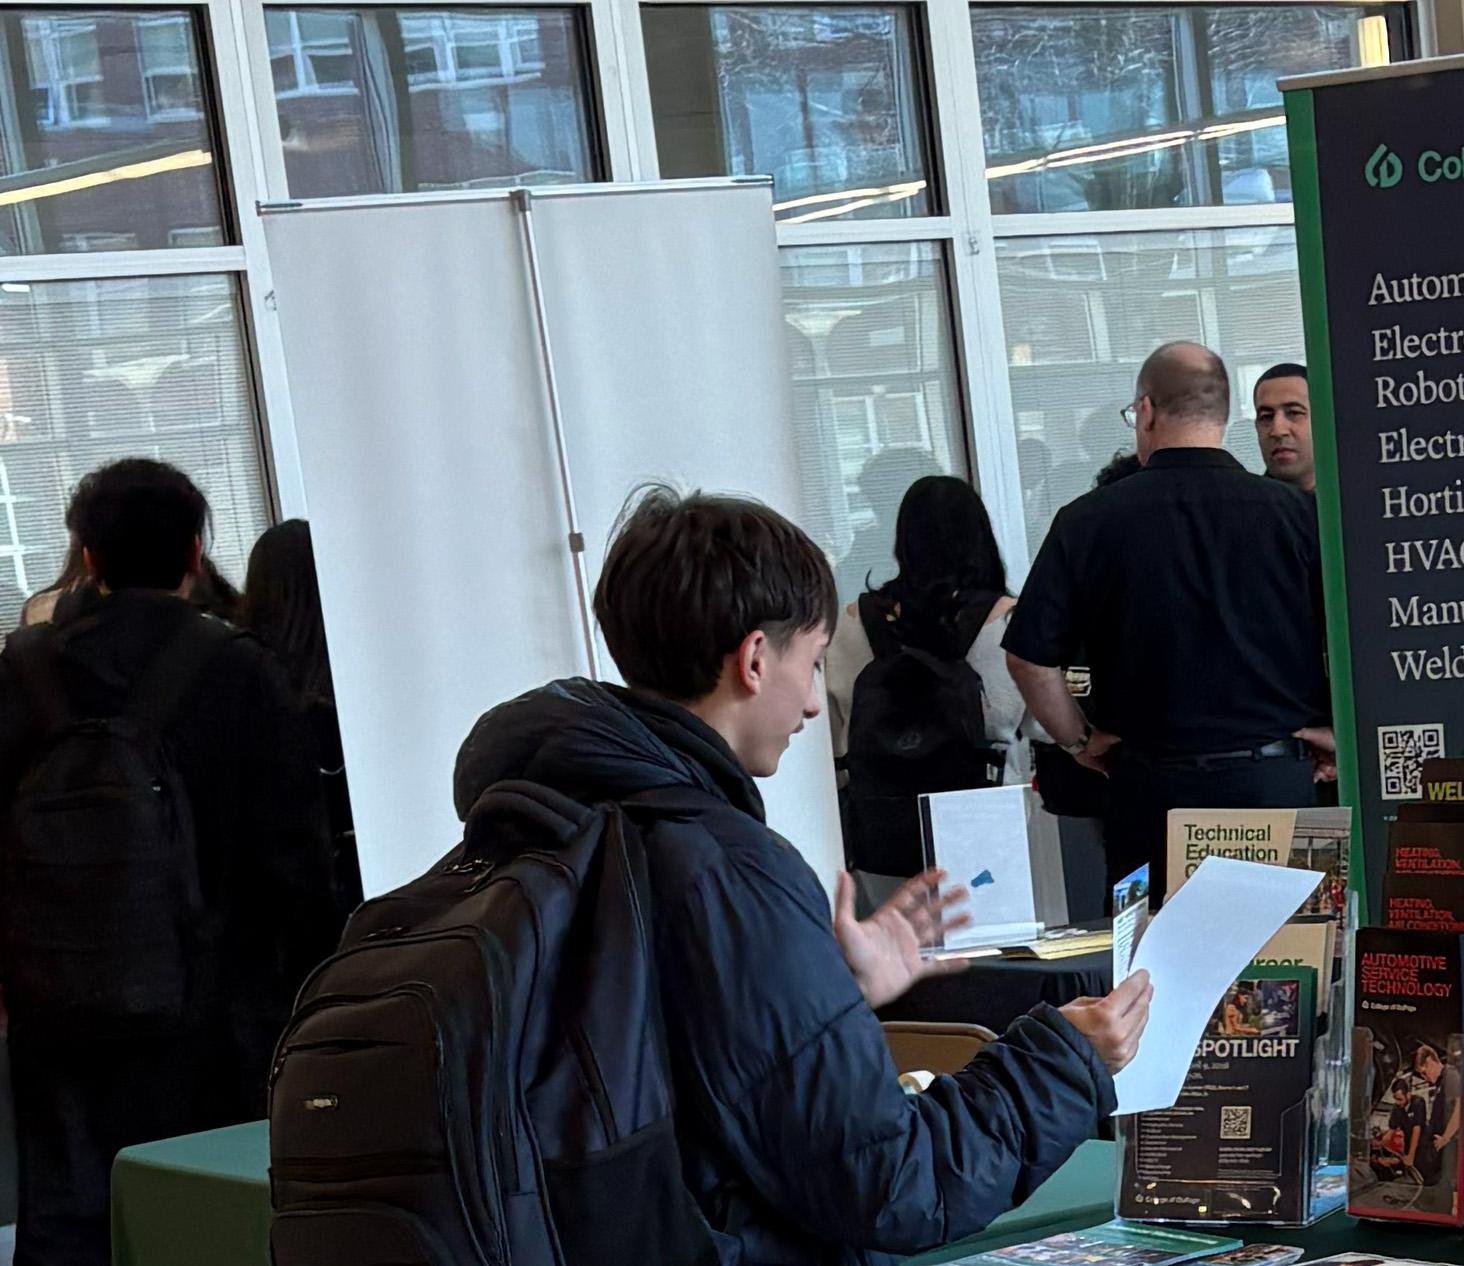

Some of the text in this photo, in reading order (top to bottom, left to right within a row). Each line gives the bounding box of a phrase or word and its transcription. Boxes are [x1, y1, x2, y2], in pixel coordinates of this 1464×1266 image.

[1184, 824, 1271, 842] Technical
[1186, 844, 1278, 862] Education
[1361, 952, 1447, 970] AUTOMOTIVE
[1361, 966, 1419, 982] SERVICE
[1361, 979, 1453, 998] TECHNOLOGY
[1194, 1038, 1300, 1058] SPOTLIGHT
